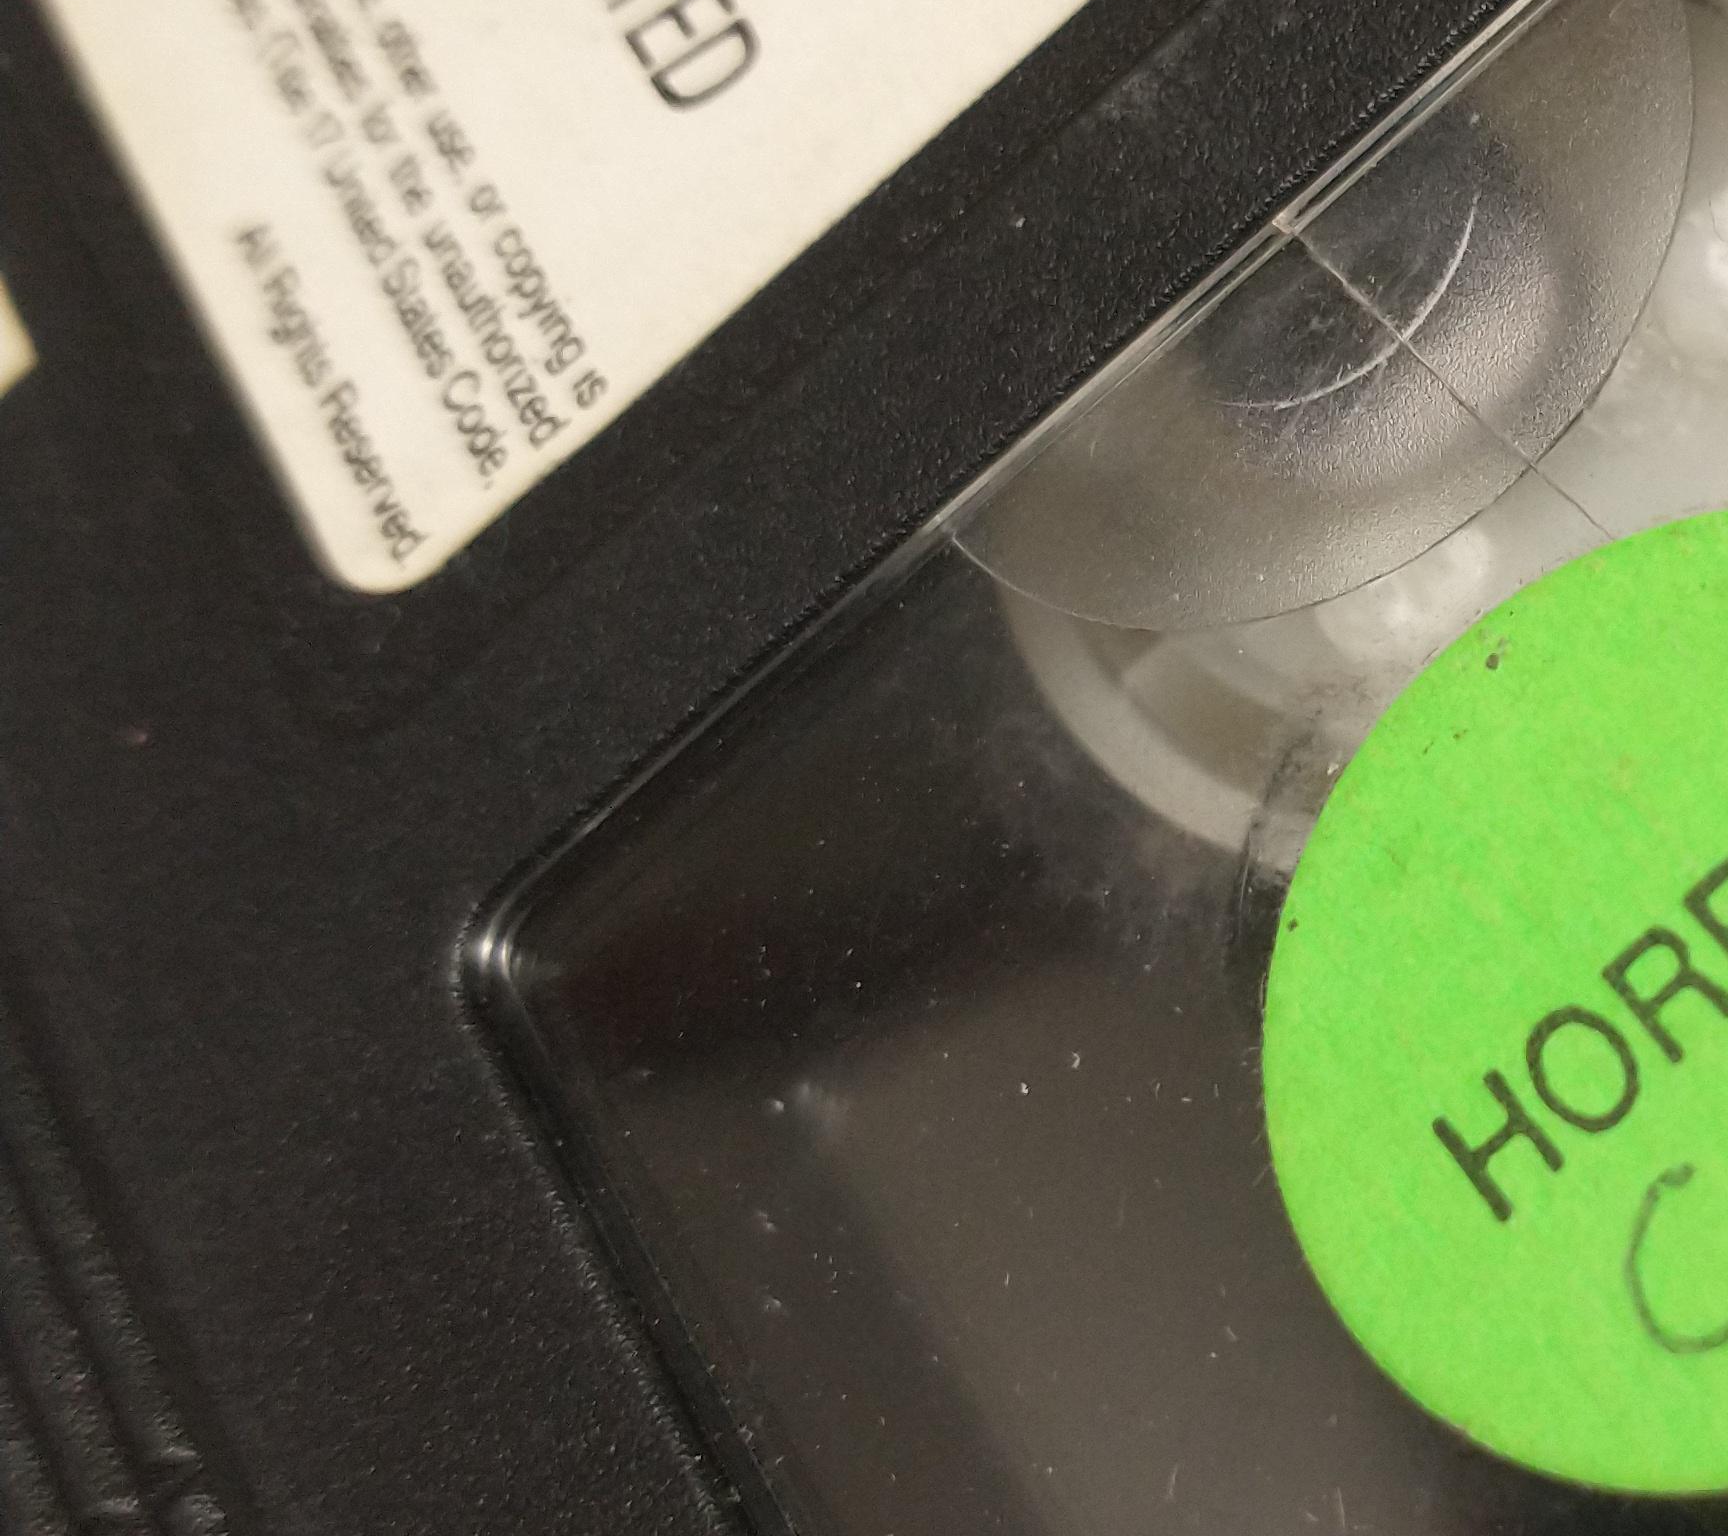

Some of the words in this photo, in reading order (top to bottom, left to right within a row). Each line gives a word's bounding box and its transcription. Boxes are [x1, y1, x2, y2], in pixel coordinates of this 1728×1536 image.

[323, 148, 397, 266] United
[380, 257, 454, 380] States
[424, 219, 569, 450] unauthorized
[467, 182, 505, 220] or
[494, 225, 586, 376] copying
[574, 368, 607, 409] is
[233, 220, 278, 267] All
[262, 266, 331, 389] Rights
[321, 378, 428, 565] Reserved
